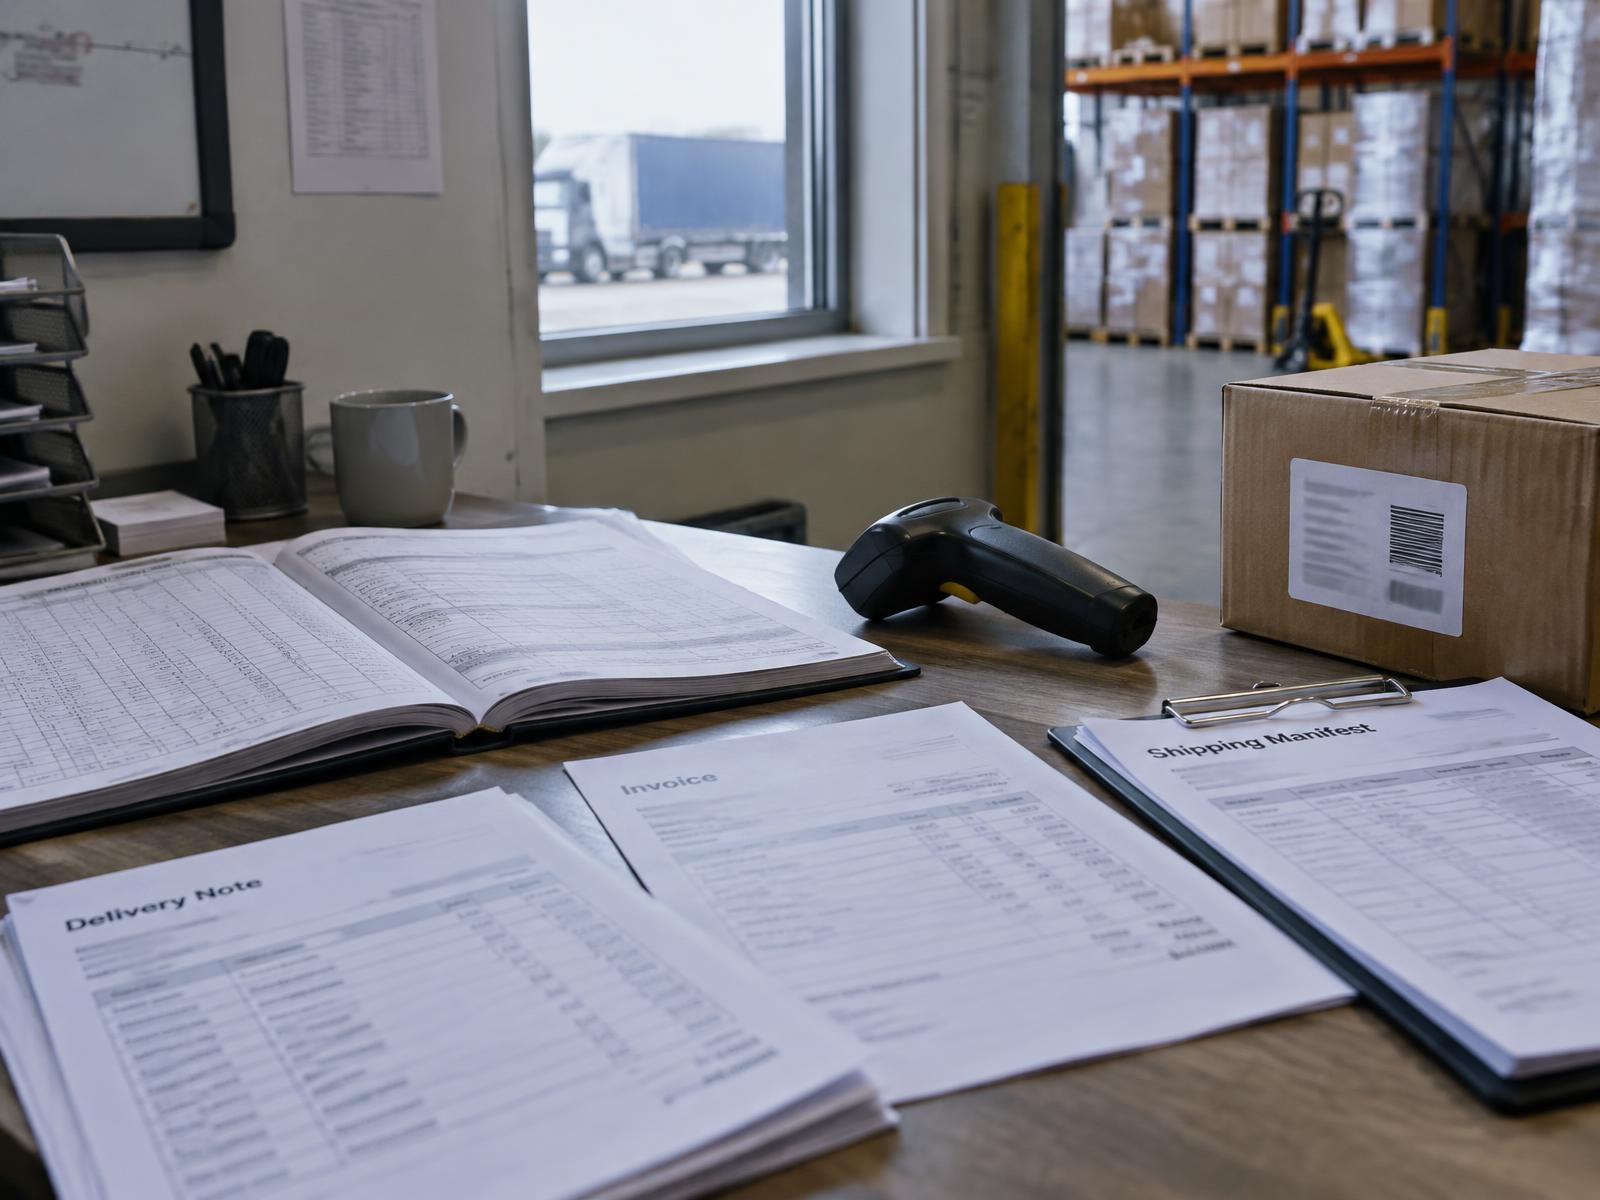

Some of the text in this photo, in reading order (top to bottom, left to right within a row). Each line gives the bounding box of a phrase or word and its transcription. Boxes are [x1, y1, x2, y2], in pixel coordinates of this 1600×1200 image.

[1147, 722, 1377, 759] Shipping Manifest
[620, 774, 718, 795] Invoice
[65, 878, 263, 932] Delivery Note
